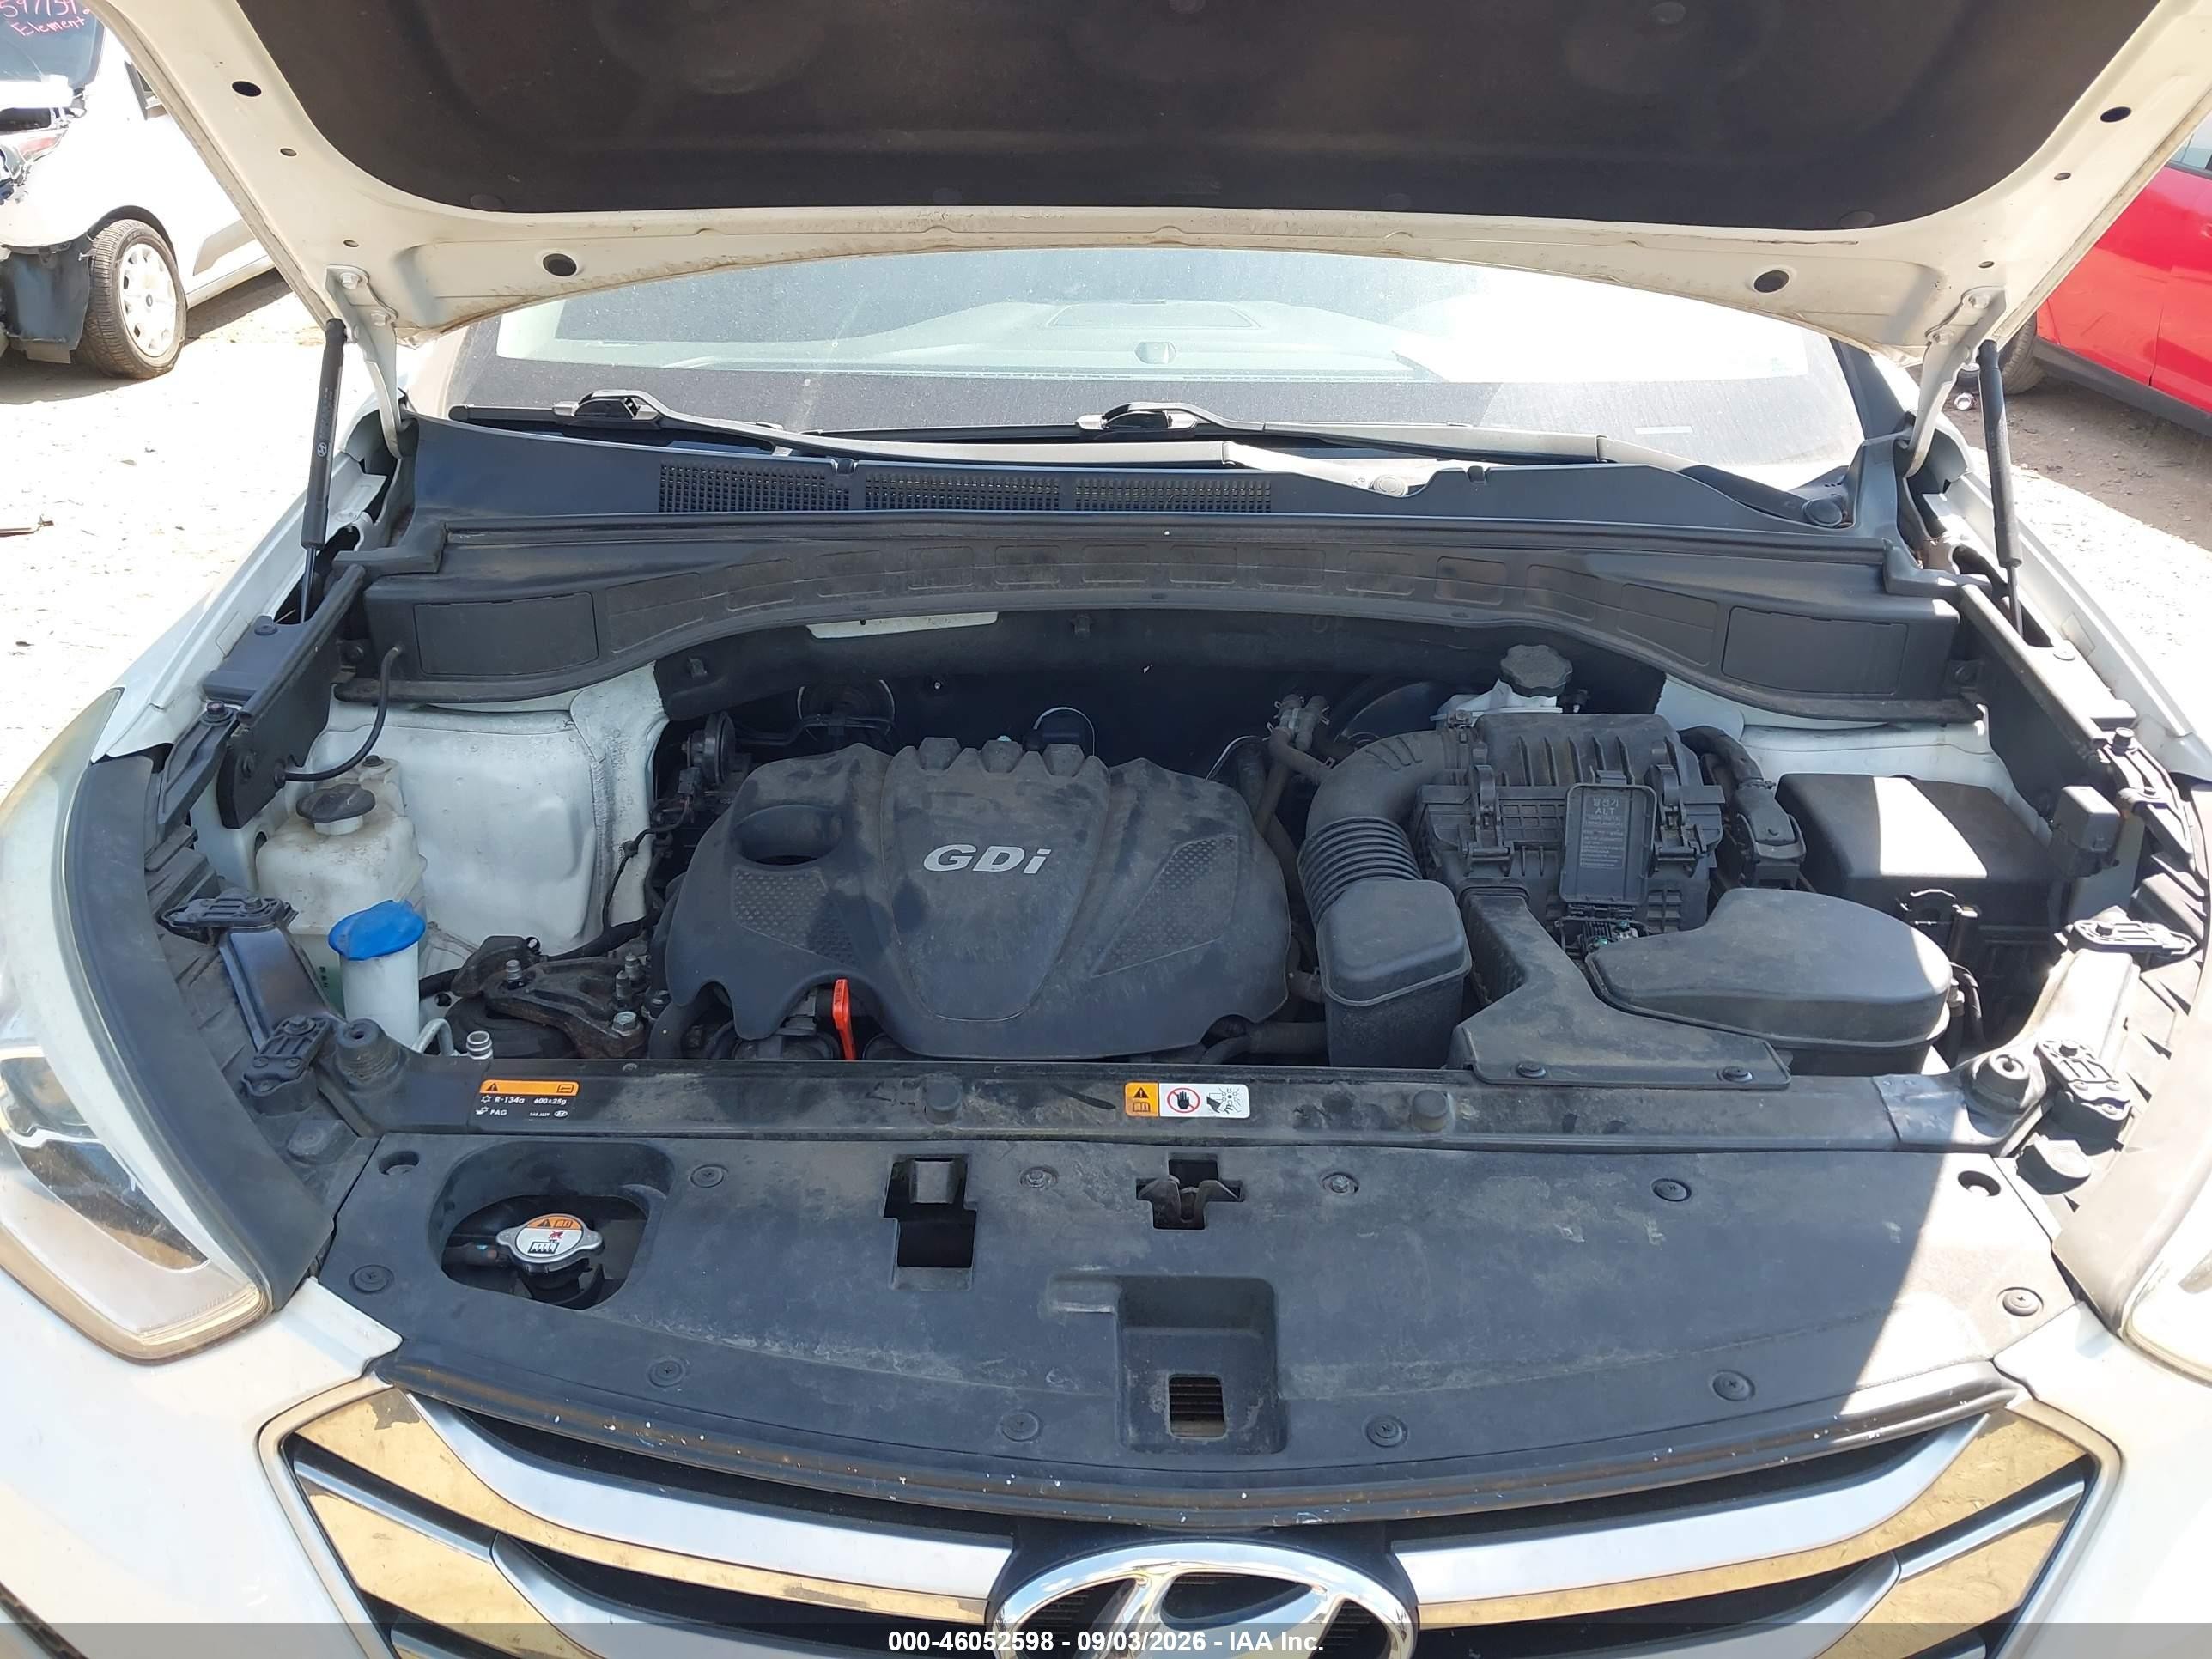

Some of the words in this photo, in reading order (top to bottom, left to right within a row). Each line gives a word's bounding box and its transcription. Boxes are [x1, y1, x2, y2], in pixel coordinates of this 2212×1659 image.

[10, 16, 85, 36] Element
[1595, 807, 1615, 816] ALT
[923, 844, 1052, 874] GDi
